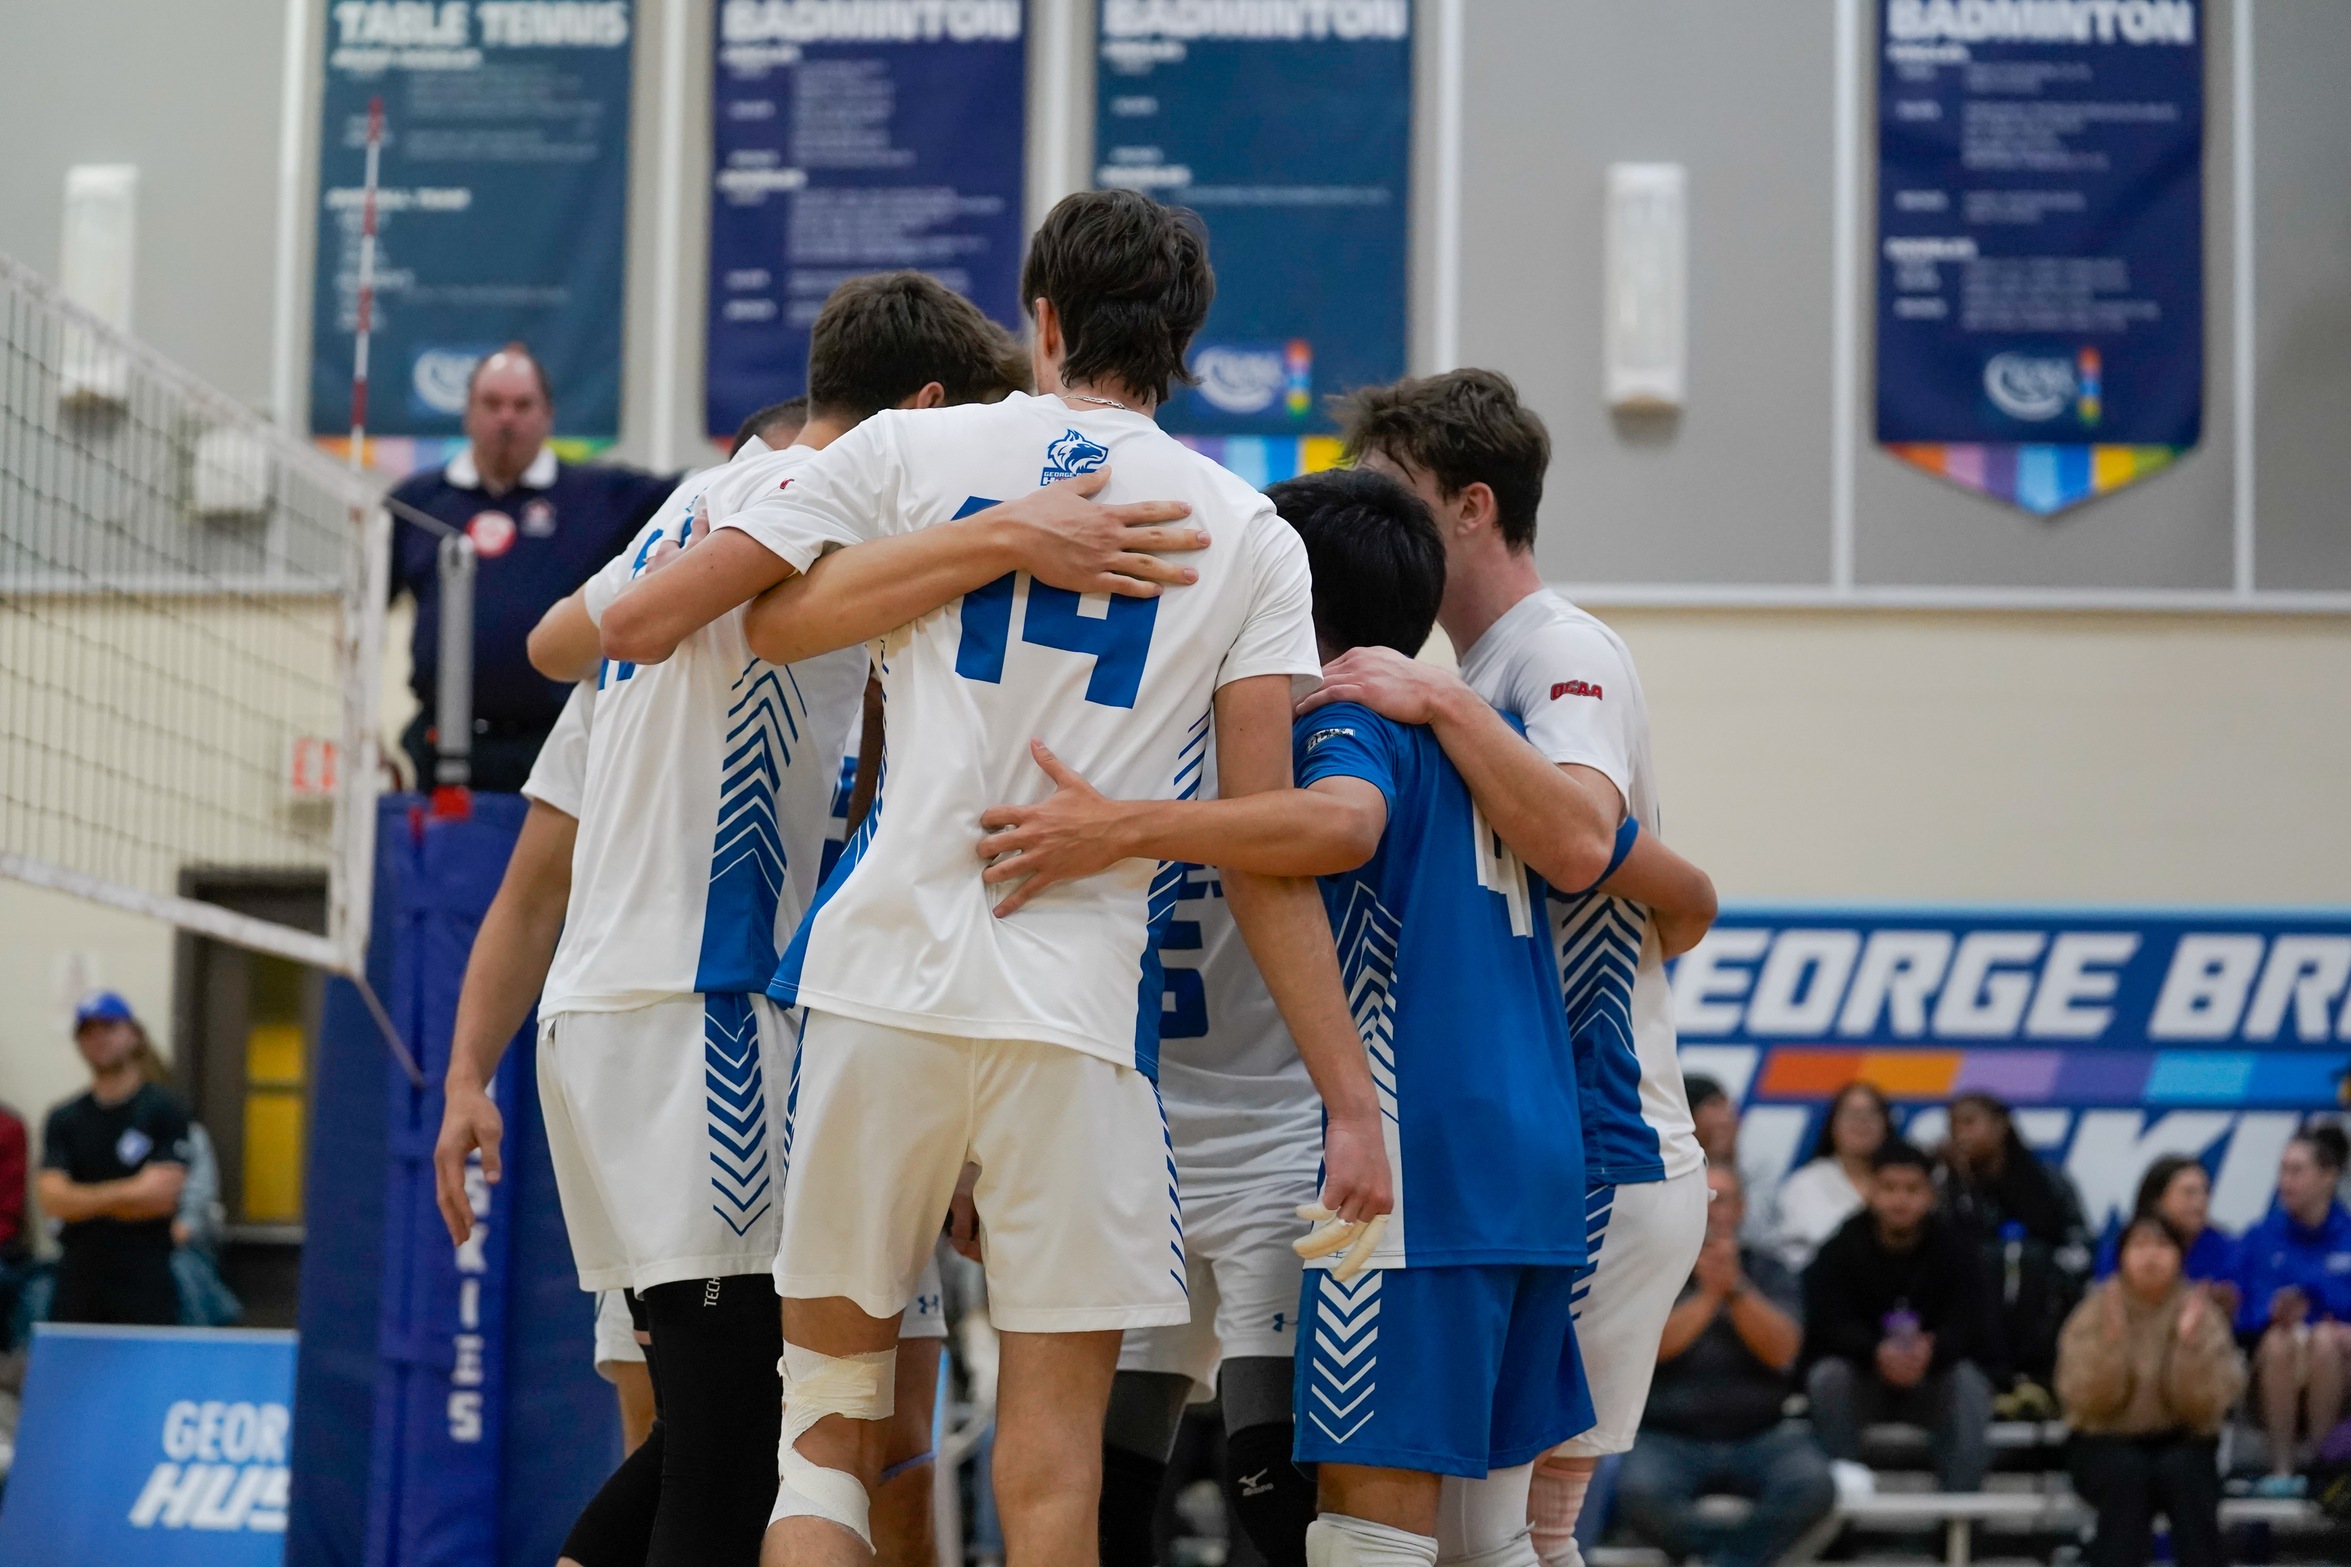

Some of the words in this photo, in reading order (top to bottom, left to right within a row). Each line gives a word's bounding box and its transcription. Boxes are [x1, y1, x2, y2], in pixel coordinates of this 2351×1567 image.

[333, 2, 470, 46] TABLE
[477, 2, 628, 47] TENNIS
[720, 0, 1021, 42] BADMINTON
[1101, 0, 1409, 39] BADMINTON
[1886, 0, 2195, 43] BADMINTON
[1670, 928, 2142, 1039] EORGE
[2147, 933, 2351, 1042] BR
[162, 1399, 290, 1464] GEOR
[127, 1461, 291, 1532] HUS
